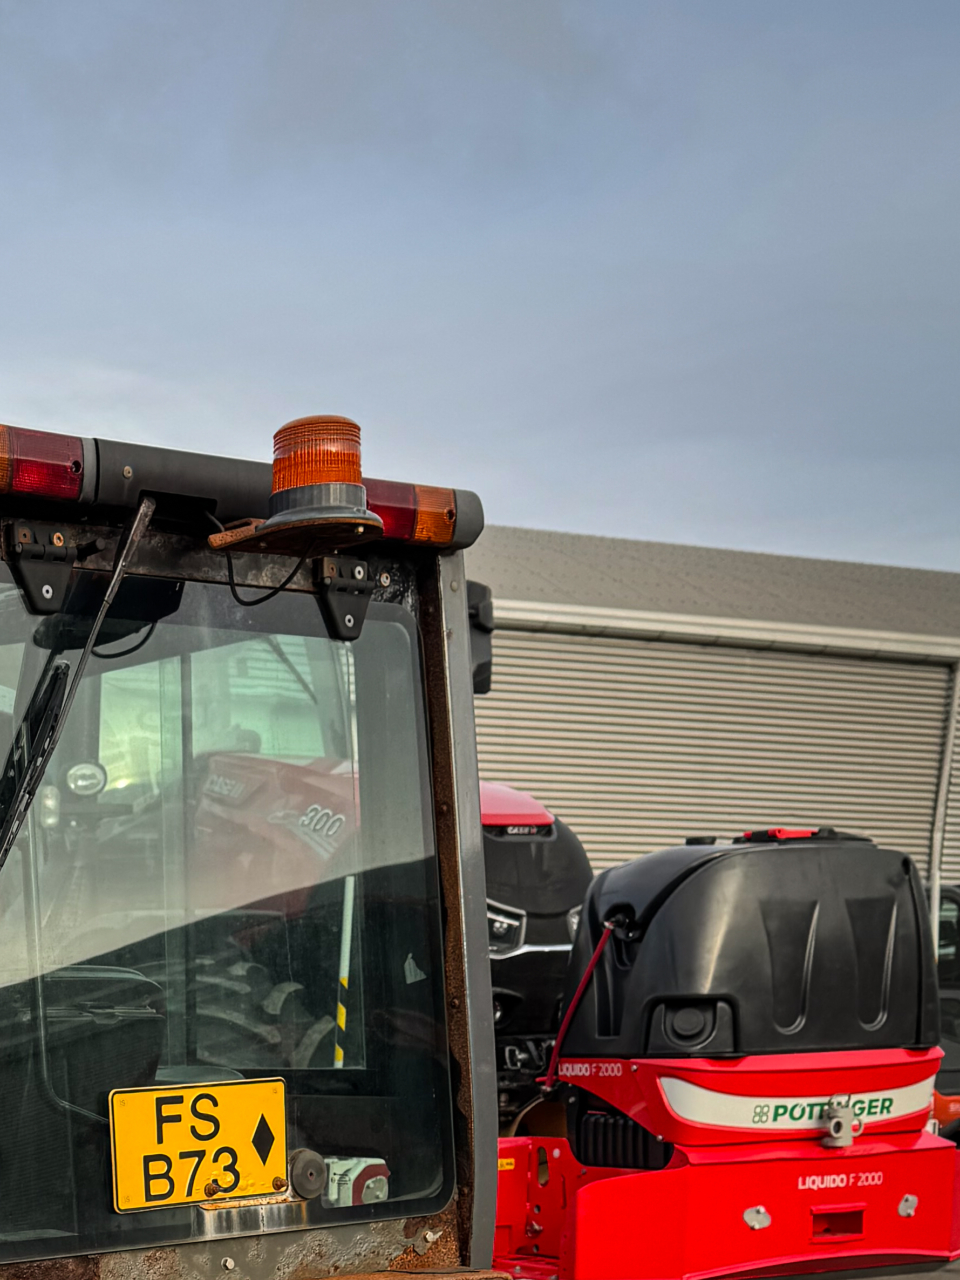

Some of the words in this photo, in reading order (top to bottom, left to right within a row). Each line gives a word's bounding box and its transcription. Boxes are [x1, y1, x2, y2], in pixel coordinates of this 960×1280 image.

[298, 804, 346, 836] 300
[558, 1063, 590, 1077] LIQUIDO
[591, 1063, 598, 1076] F
[599, 1062, 622, 1077] 2000
[154, 1092, 221, 1145] FS
[772, 1097, 894, 1122] PÖTTGER
[142, 1146, 241, 1203] B73
[797, 1174, 847, 1190] LIQUIDO
[849, 1174, 855, 1187] F
[857, 1171, 884, 1186] 2000
